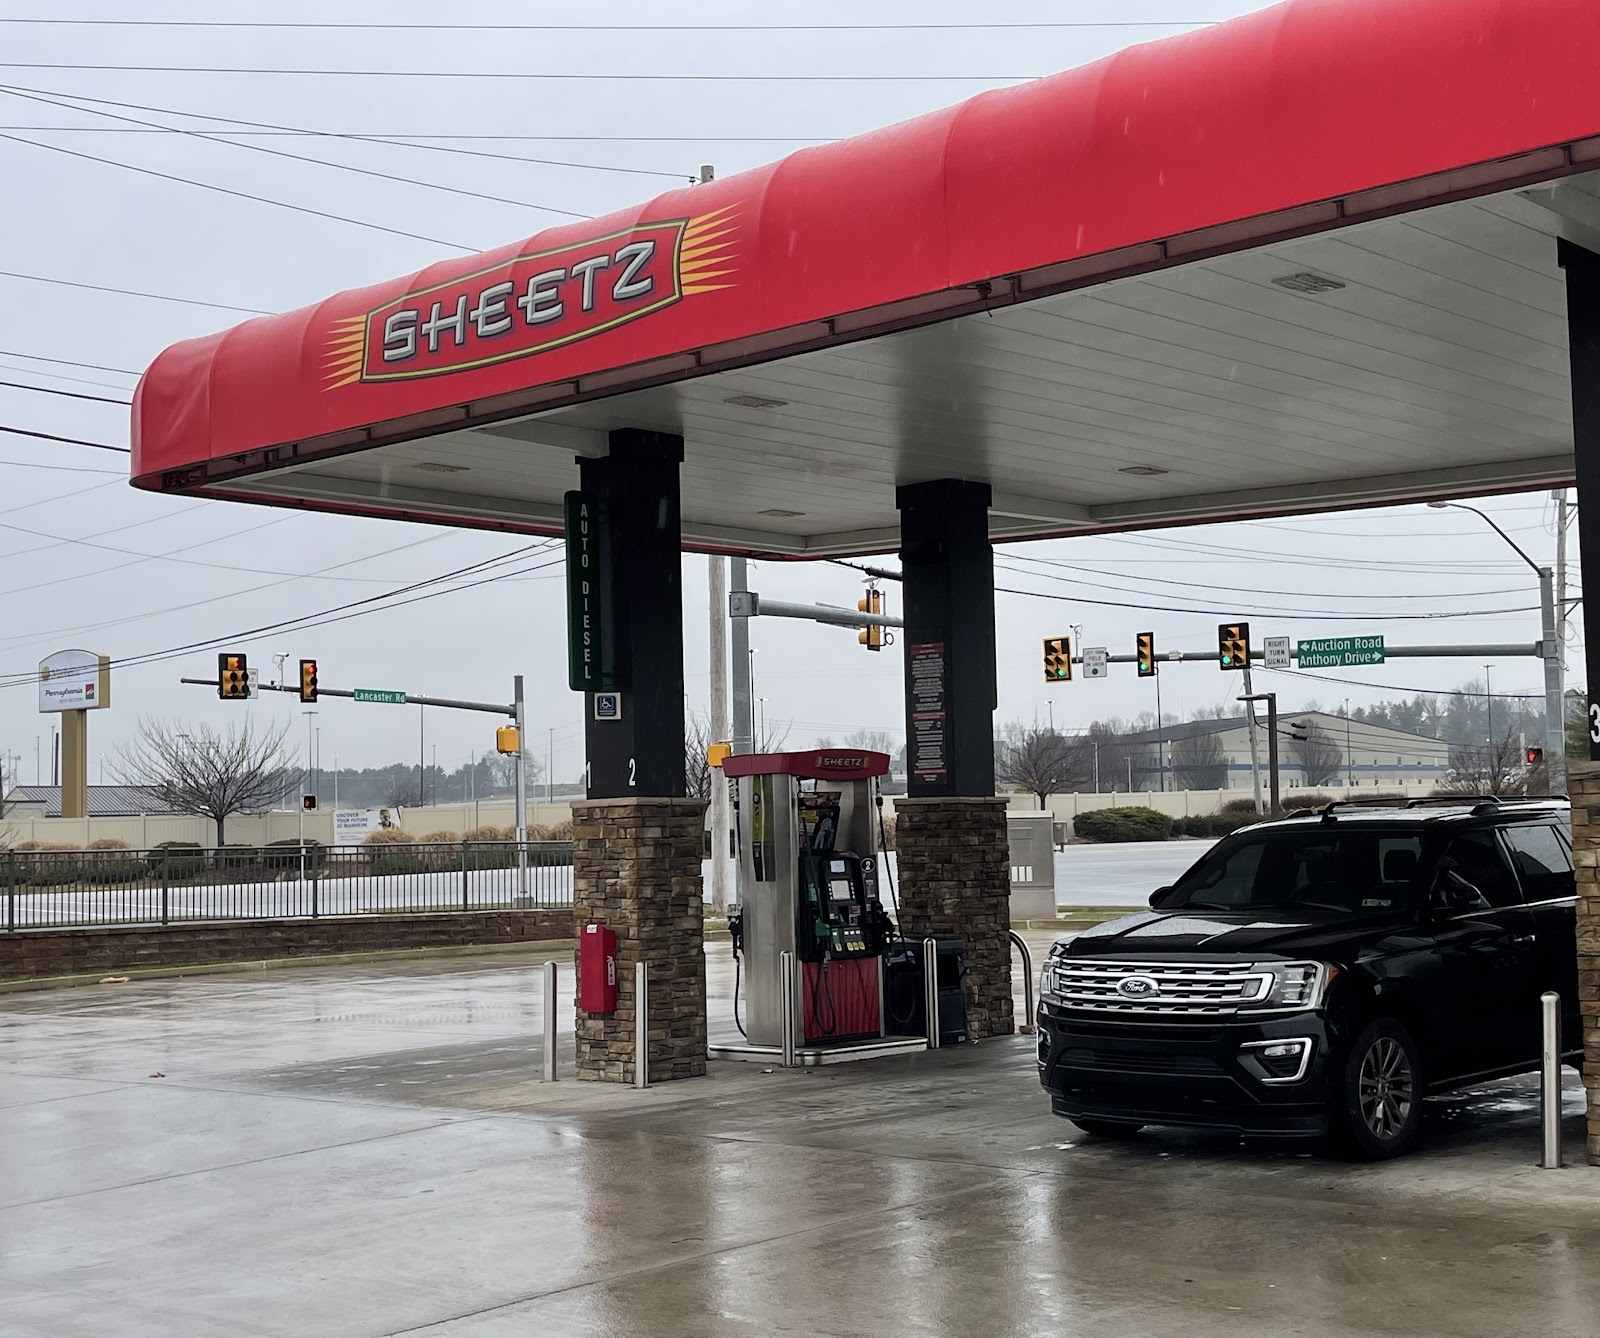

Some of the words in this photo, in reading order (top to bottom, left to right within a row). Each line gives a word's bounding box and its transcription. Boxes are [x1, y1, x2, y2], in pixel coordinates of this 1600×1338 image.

[382, 240, 656, 362] SHEETZ
[580, 503, 589, 569] AUTO
[582, 580, 592, 680] DIESEL
[1267, 640, 1285, 648] RIGHT
[1311, 638, 1351, 652] Auction
[1354, 636, 1382, 649] Road
[1266, 657, 1288, 666] SIGNAL
[1299, 653, 1342, 667] Anthony
[1345, 651, 1371, 664] Drive
[45, 687, 83, 699] Pennsylvania
[355, 690, 393, 702] Lancaster
[395, 692, 405, 703] Rd
[1589, 703, 1600, 743] 3
[823, 757, 863, 767] SHEETZ
[586, 761, 591, 789] 1
[628, 758, 636, 786] 2
[864, 859, 871, 870] 2
[1125, 980, 1146, 992] Ford
